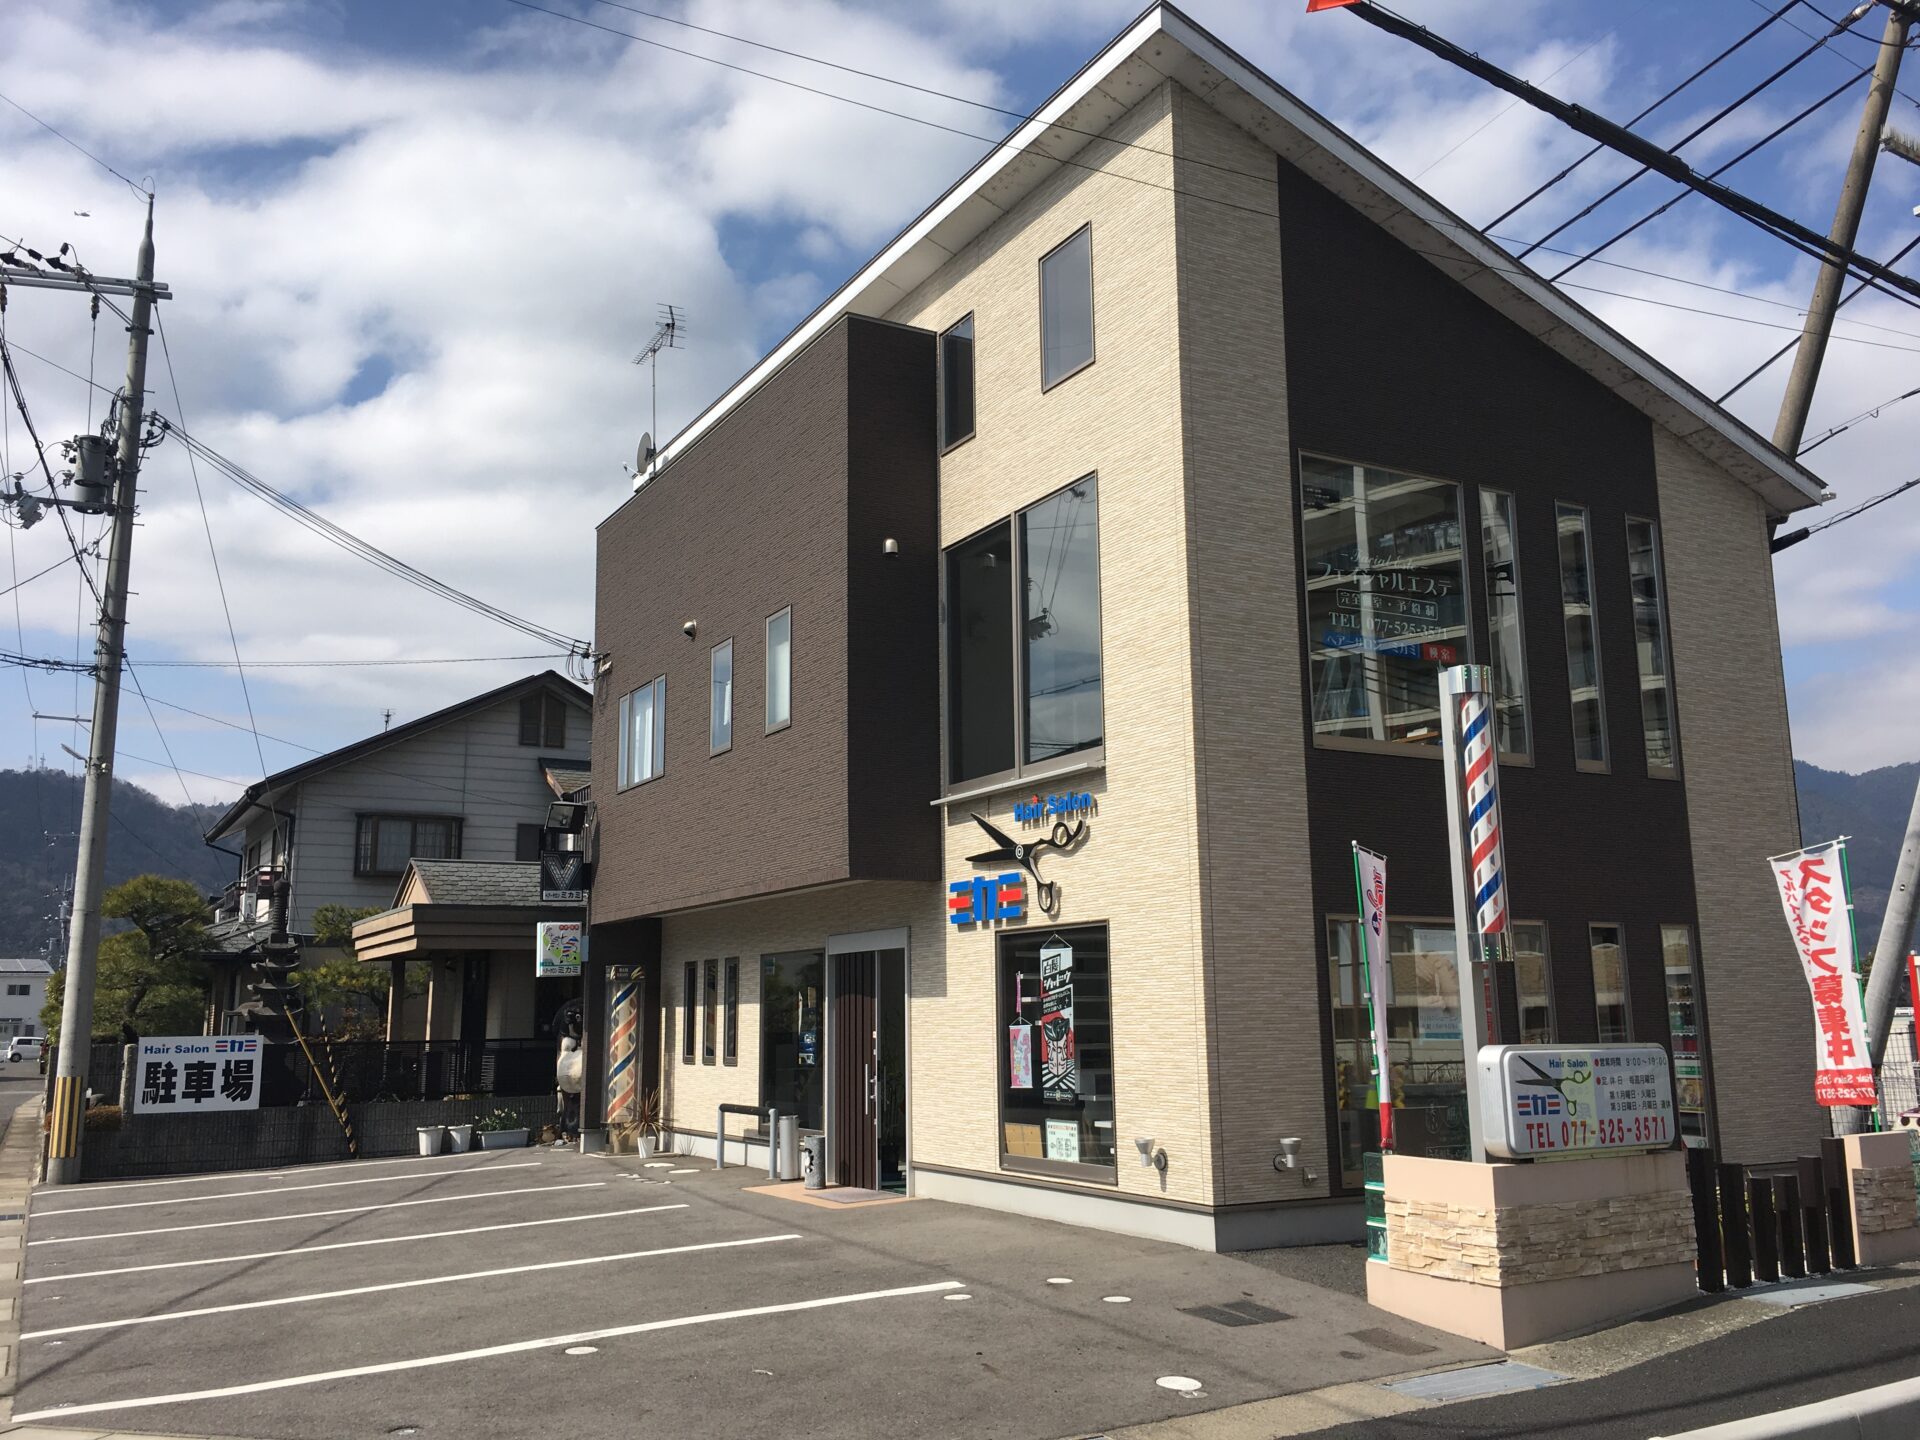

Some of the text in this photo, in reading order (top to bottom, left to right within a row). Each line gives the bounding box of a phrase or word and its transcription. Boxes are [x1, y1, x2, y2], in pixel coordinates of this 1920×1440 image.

[1318, 562, 1453, 597] フェイシャルエステ
[1329, 612, 1361, 629] TEL
[1391, 643, 1417, 657] ミカミ
[1013, 791, 1092, 822] Hair Salon
[561, 891, 581, 899] ミカミ
[949, 872, 1023, 924] ミカミ
[558, 966, 579, 974] ミカミ
[144, 1039, 257, 1055] Hair Salon ミカミ
[1548, 1057, 1588, 1068] Hair Salon
[1600, 1057, 1622, 1068] 営業時間
[141, 1059, 254, 1105] 駐車場
[1517, 1094, 1561, 1116] ミカミ
[1526, 1116, 1667, 1149] TEL 077-525-3571
